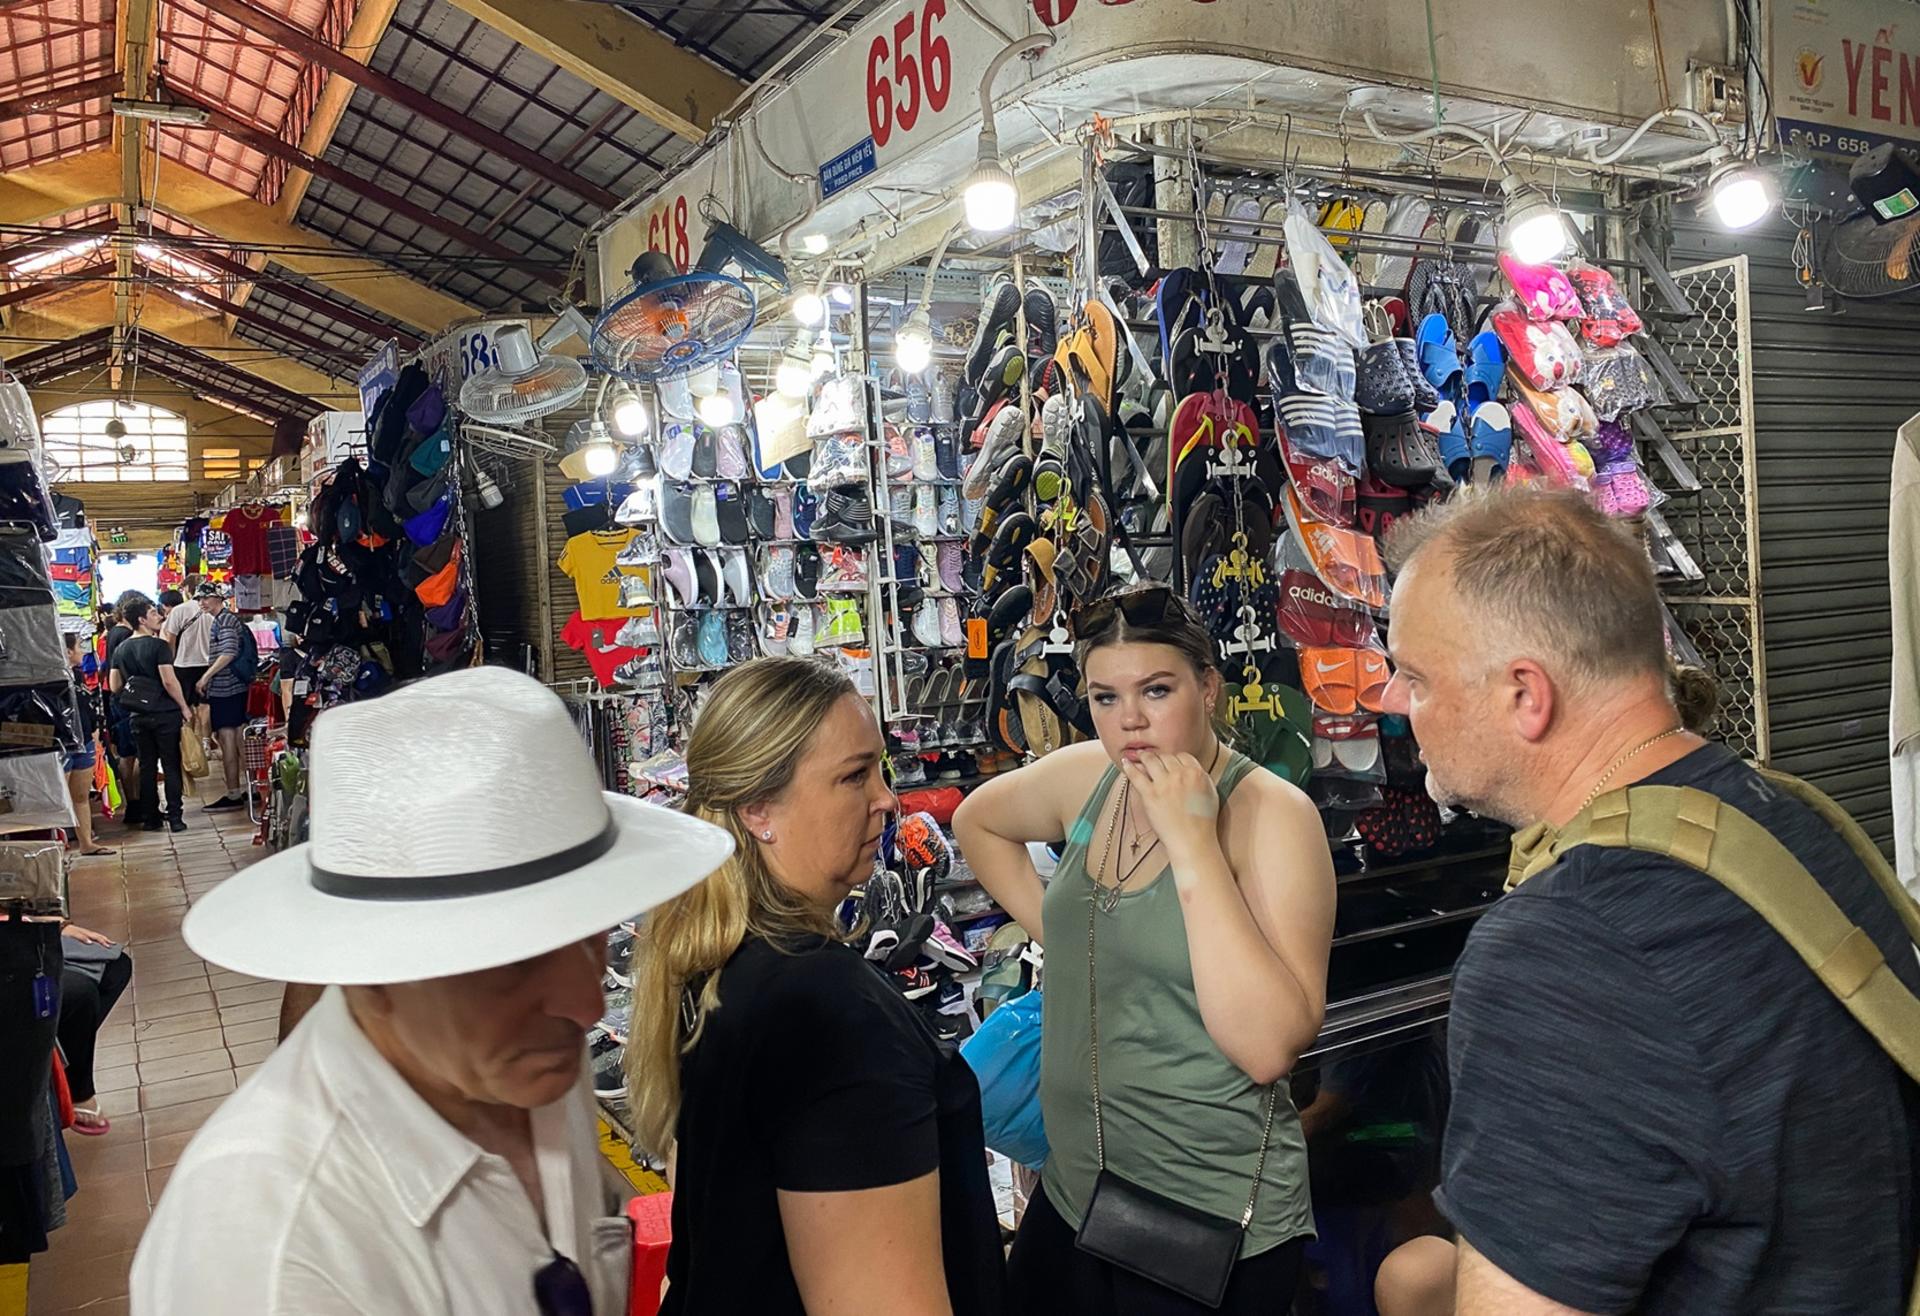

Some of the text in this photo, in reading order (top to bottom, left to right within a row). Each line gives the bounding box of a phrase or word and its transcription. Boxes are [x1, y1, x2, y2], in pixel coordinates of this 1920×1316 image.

[867, 0, 951, 147] 656
[1837, 137, 1870, 154] 658
[648, 195, 690, 275] 618
